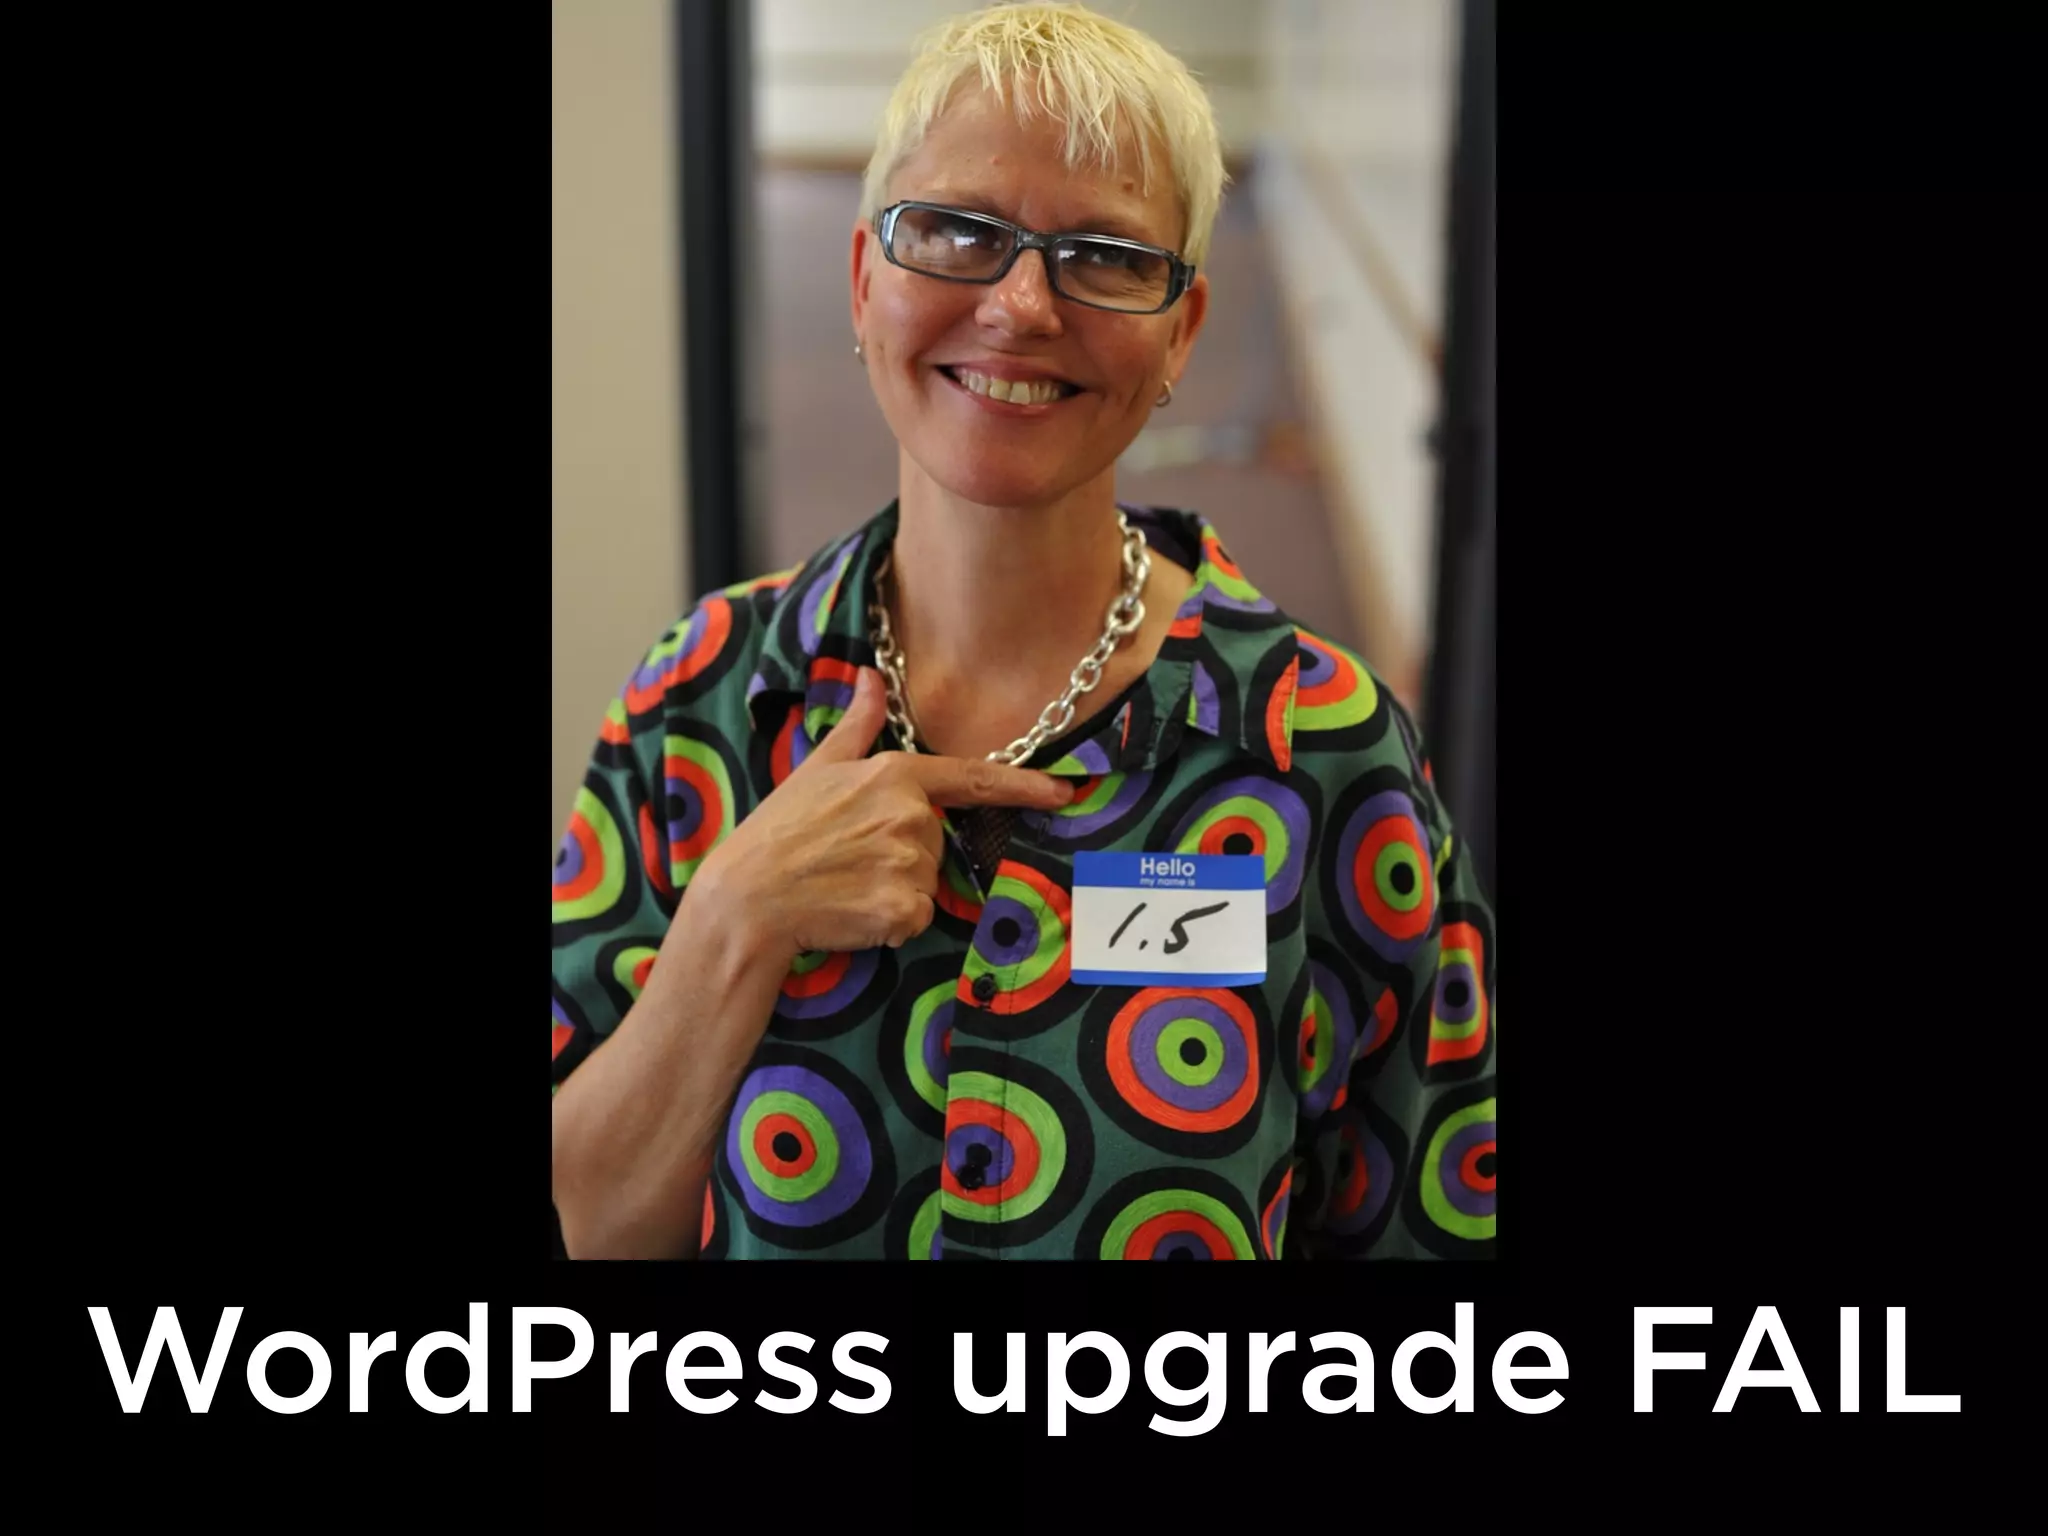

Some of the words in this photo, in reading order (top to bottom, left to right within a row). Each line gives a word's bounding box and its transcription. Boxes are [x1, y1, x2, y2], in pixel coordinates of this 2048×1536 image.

[1140, 857, 1196, 877] Hello
[1140, 878, 1155, 887] my
[1157, 878, 1186, 887] name
[1187, 878, 1196, 887] is
[1109, 902, 1230, 954] 1.5
